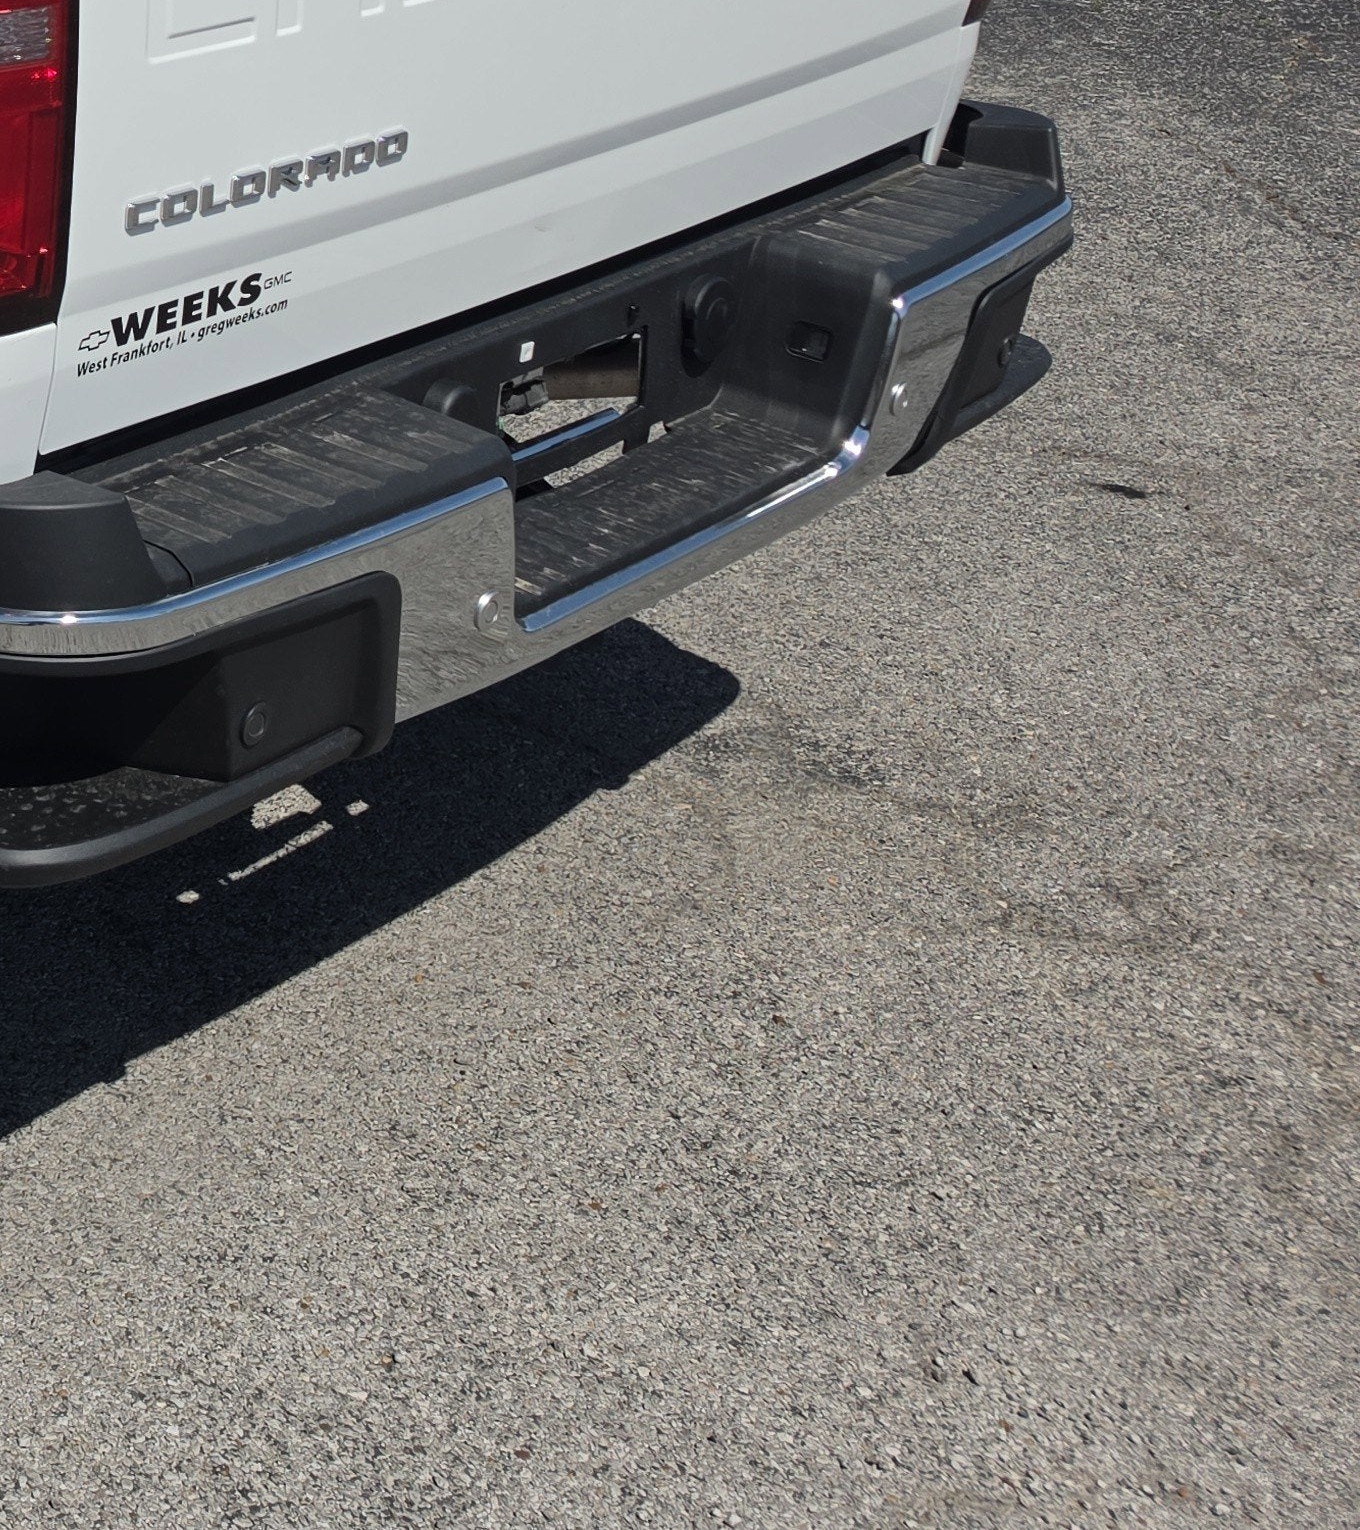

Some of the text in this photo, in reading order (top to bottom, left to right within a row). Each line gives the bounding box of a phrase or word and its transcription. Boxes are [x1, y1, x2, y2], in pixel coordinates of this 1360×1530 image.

[125, 127, 408, 236] COLORADO
[77, 298, 288, 377] West Frankfort, IL gregweeks.com
[110, 271, 293, 347] WEEKS GMC
